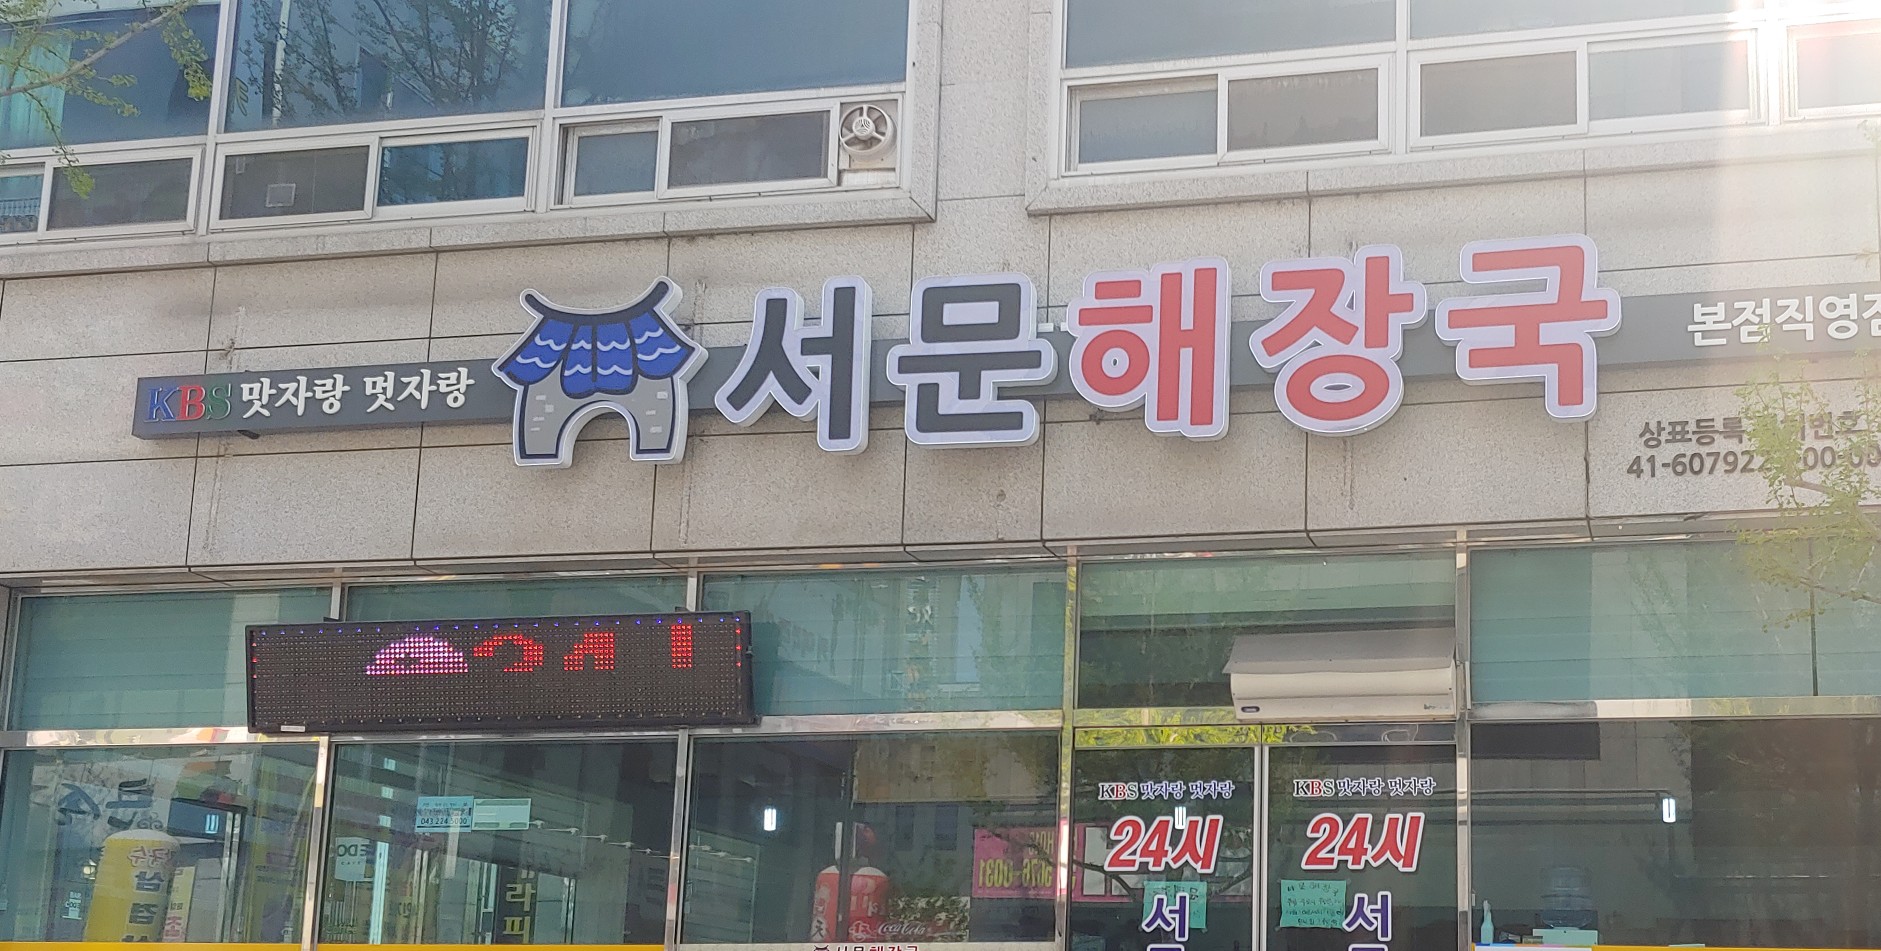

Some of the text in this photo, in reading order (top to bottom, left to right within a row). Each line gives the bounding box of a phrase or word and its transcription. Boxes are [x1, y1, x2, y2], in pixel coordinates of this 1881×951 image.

[717, 234, 1620, 453] 서문해장국
[141, 367, 475, 423] KBS 맛자랑 멋자랑
[1638, 416, 1747, 449] 상표등록
[1098, 780, 1234, 801] KBS 맛자랑 멋자랑
[1293, 777, 1436, 799] KBS 맛자랑 멋자랑
[1103, 814, 1224, 874] 24시
[1301, 812, 1425, 874] 24시
[1142, 892, 1191, 951] 서
[1343, 890, 1393, 951] 서
